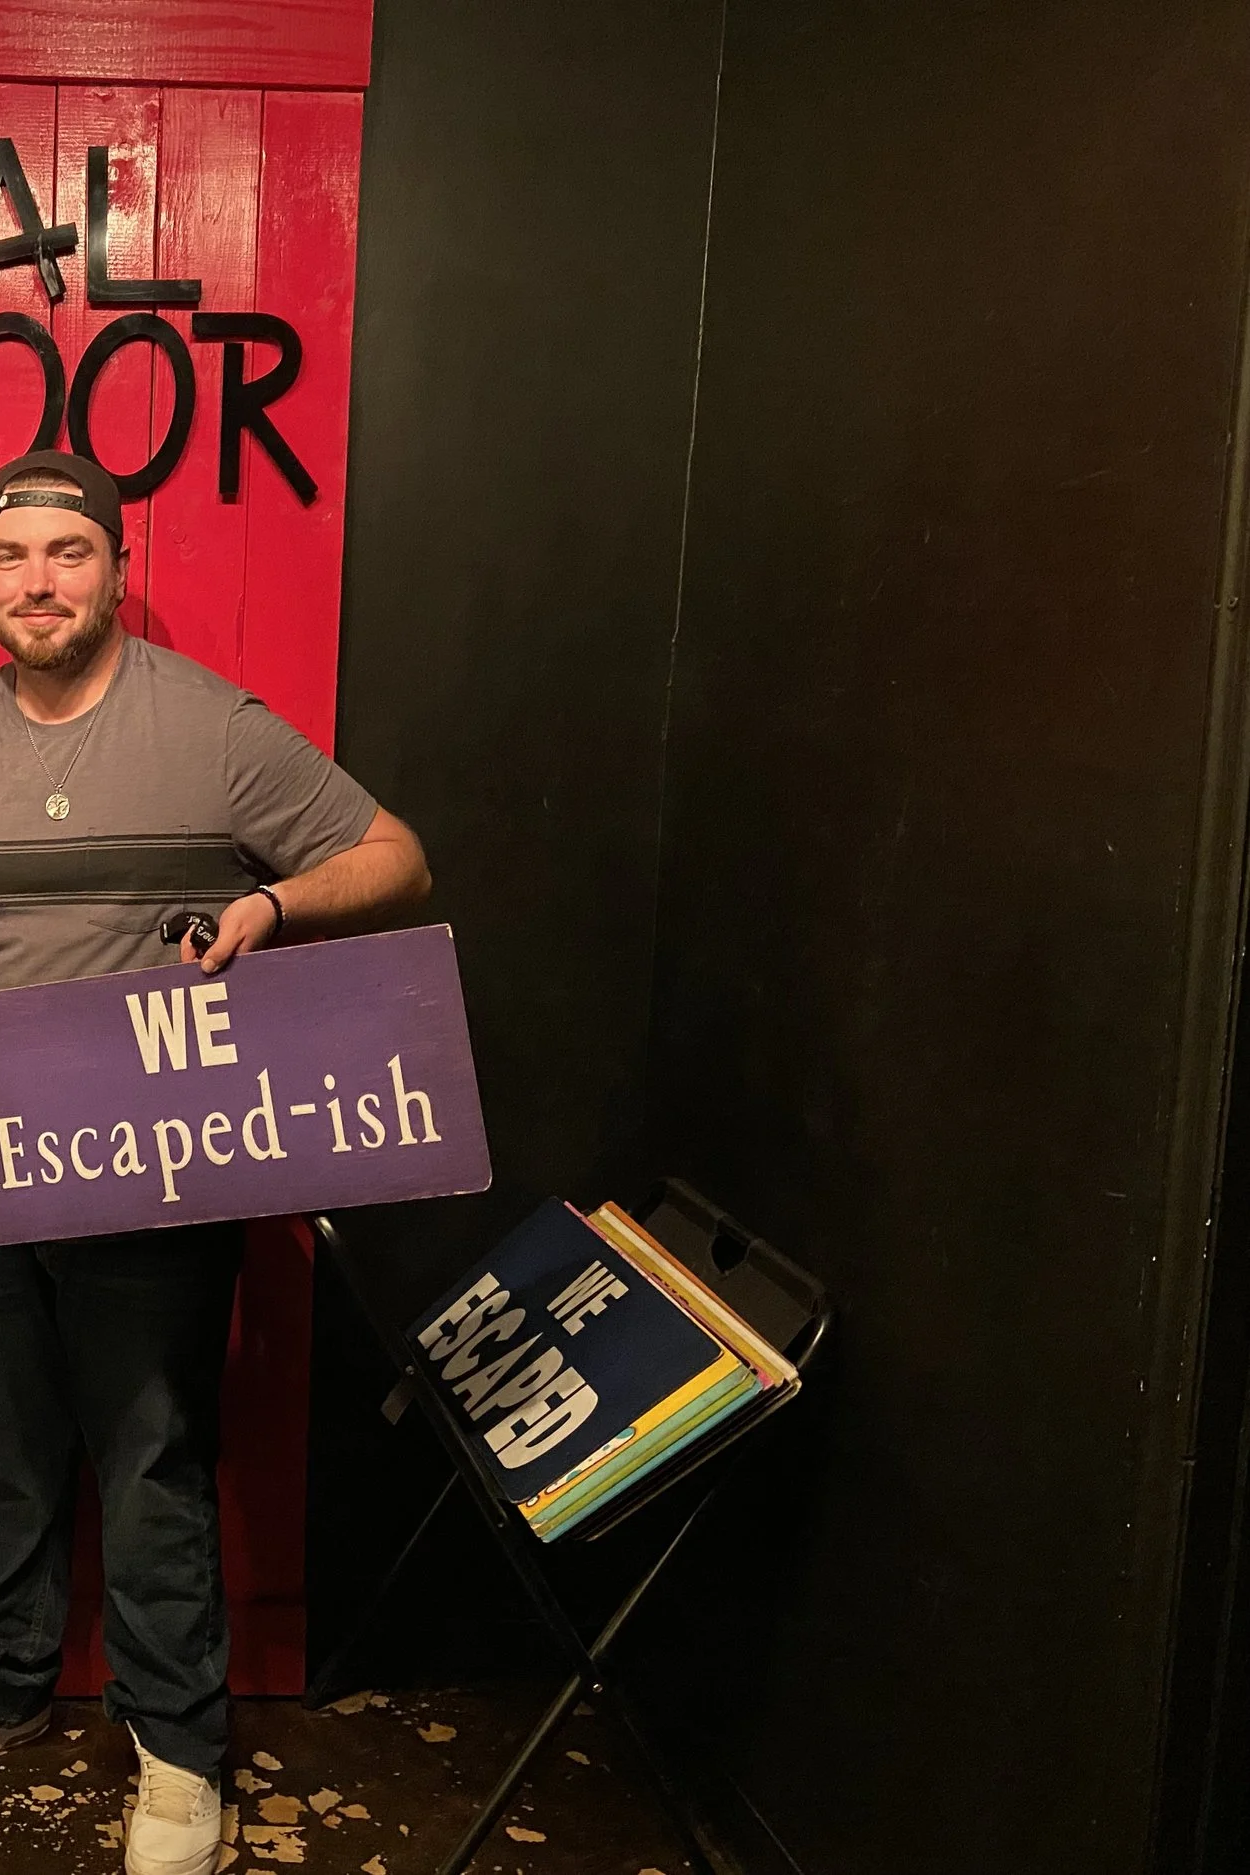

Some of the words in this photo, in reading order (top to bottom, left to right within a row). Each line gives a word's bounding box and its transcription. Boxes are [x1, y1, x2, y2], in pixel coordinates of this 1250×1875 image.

[125, 982, 238, 1074] WE
[546, 1260, 630, 1337] WE
[417, 1272, 599, 1469] ESCAPED
